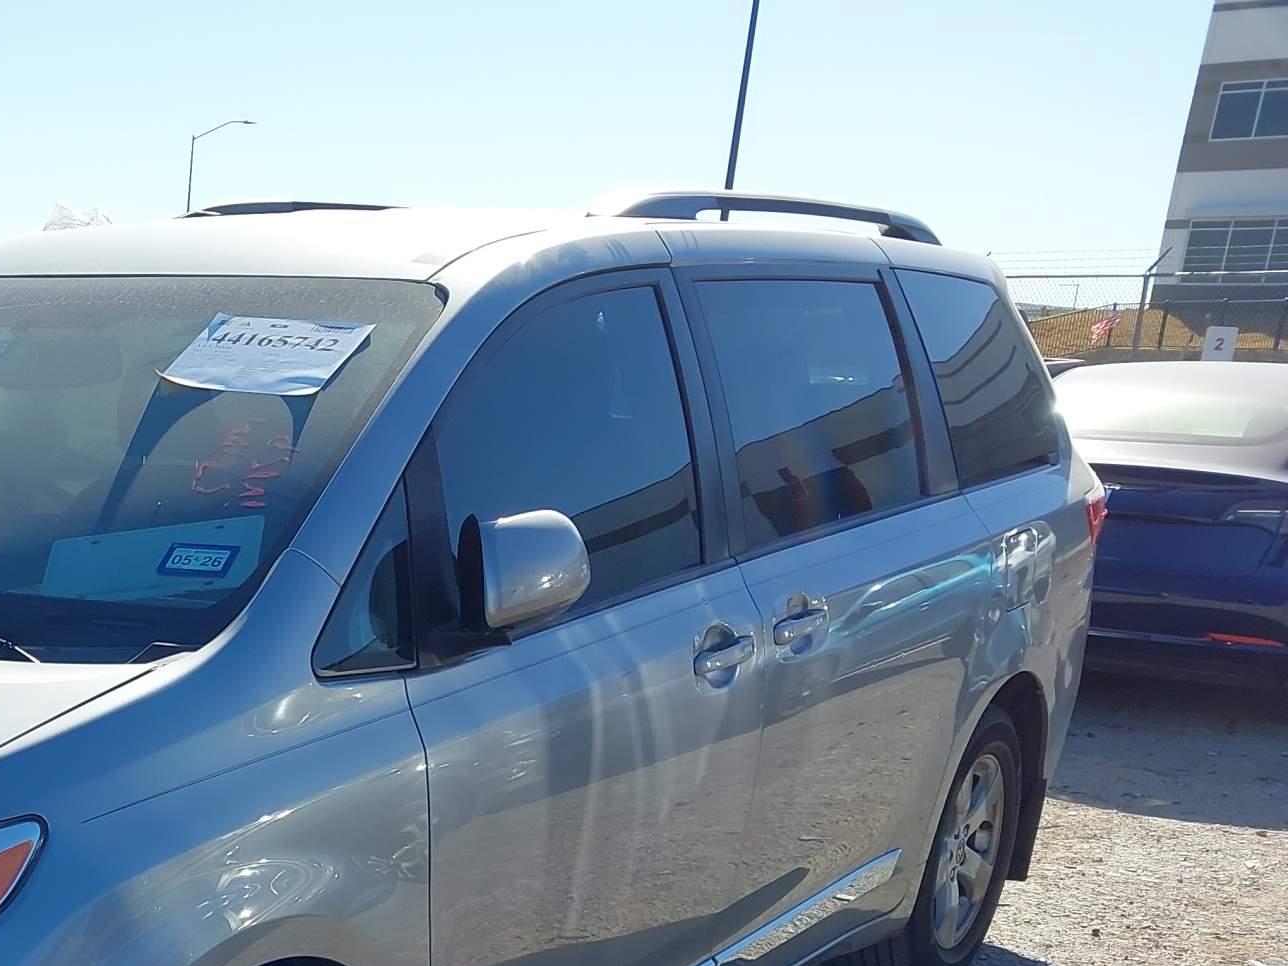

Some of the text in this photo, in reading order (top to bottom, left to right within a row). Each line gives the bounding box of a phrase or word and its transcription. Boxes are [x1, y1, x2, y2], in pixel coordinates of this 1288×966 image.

[212, 331, 340, 351] 44165742
[1214, 337, 1225, 351] 2
[171, 554, 224, 568] 05 26
